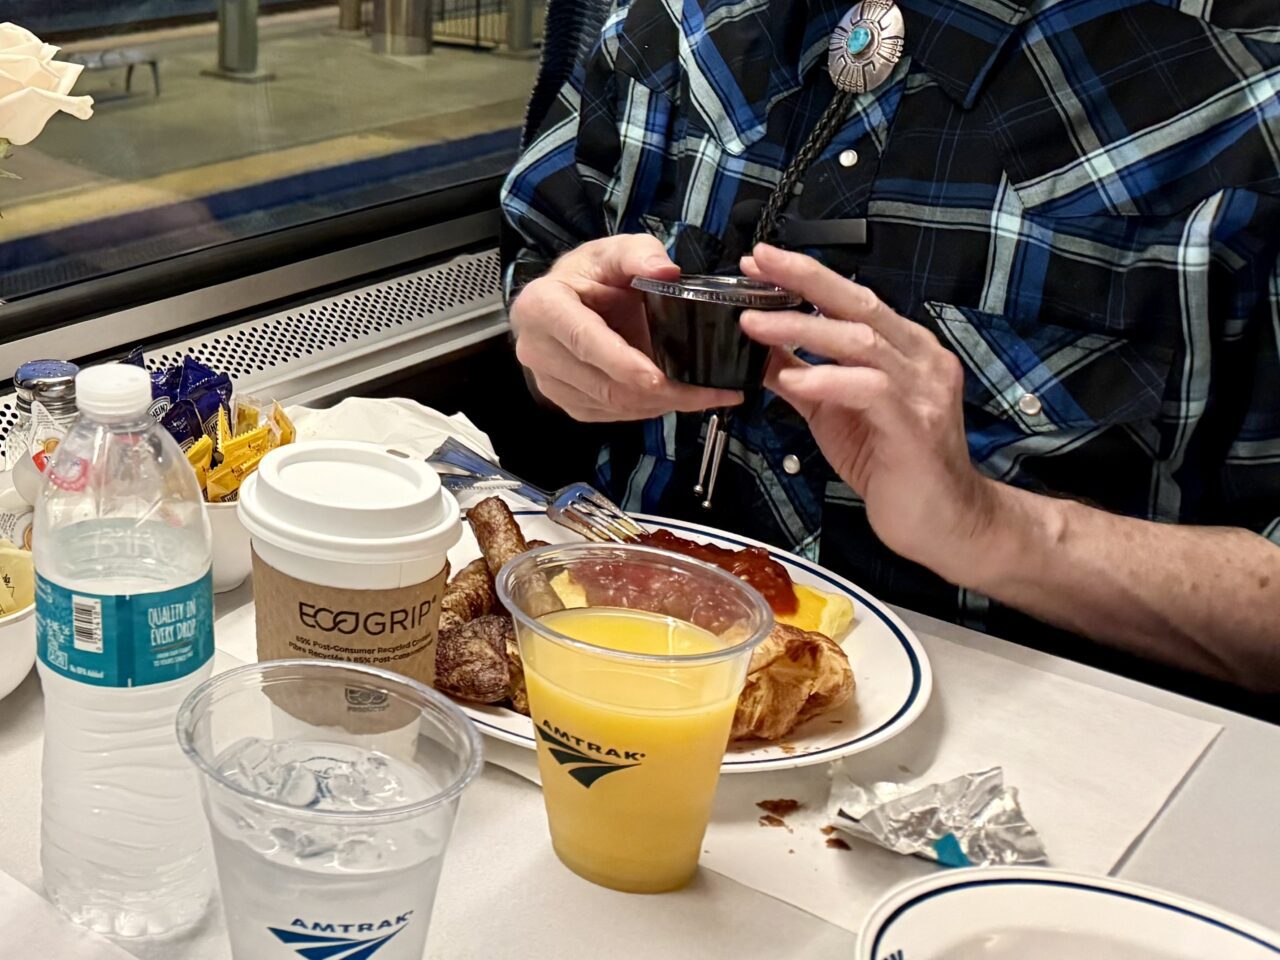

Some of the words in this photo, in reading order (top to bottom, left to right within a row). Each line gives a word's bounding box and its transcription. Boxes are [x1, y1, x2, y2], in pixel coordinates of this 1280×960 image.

[148, 602, 185, 629] QUALITY
[186, 597, 197, 618] IN
[151, 625, 176, 646] EVERY
[176, 619, 197, 640] DROP
[312, 640, 376, 655] Post-Consumer
[377, 639, 411, 654] Recycled
[353, 656, 371, 664] 85%
[543, 719, 644, 761] AMTRAK
[291, 912, 411, 933] AMTRAK
